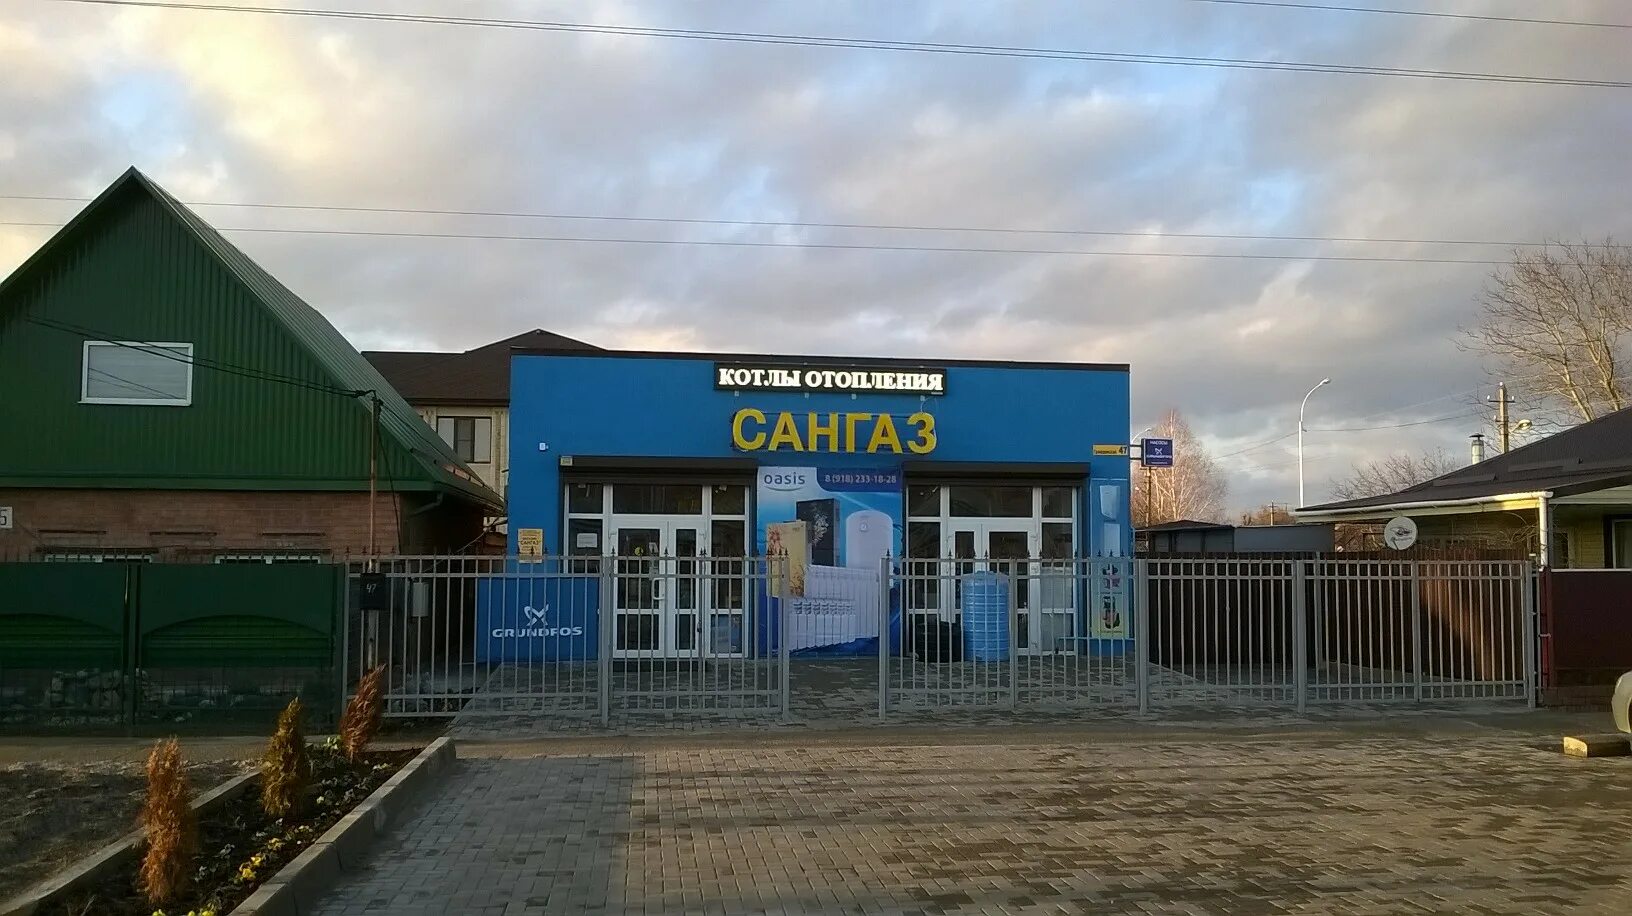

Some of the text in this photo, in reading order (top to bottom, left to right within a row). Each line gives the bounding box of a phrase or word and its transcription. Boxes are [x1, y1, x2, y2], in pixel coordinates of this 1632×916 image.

[719, 368, 943, 390] КОТЛЫ ОТОПЛЕНИЯ
[732, 408, 937, 454] САНГАЗ
[1119, 446, 1127, 454] 47
[764, 472, 805, 485] oasis
[832, 475, 853, 484] (918)
[856, 475, 896, 483] 233-18-28
[366, 583, 377, 593] 47
[492, 626, 583, 638] GRUNDFOS
